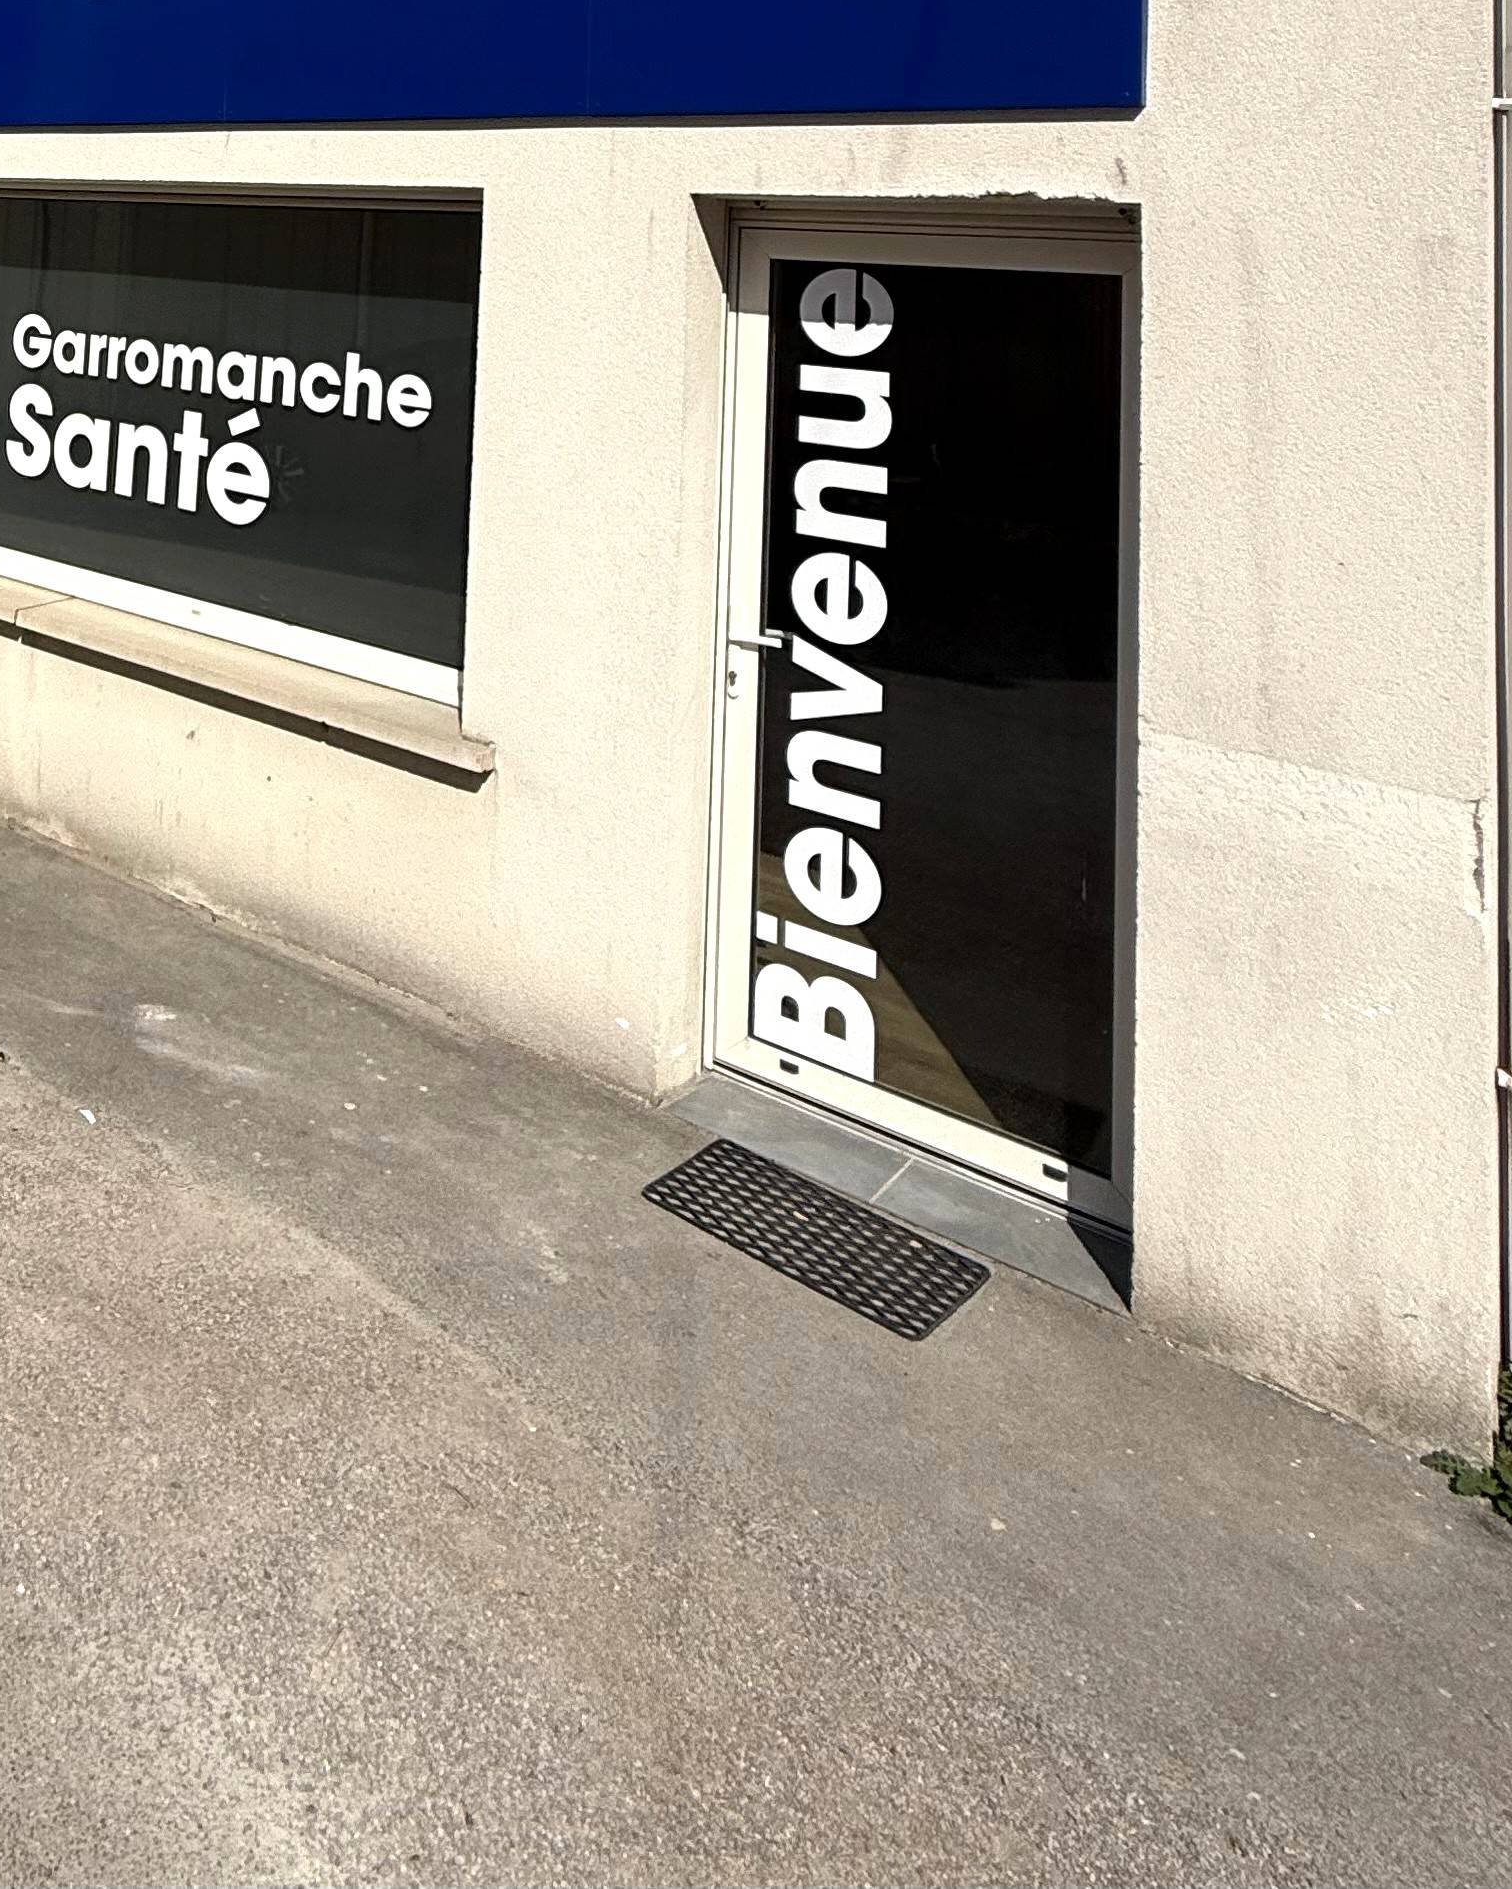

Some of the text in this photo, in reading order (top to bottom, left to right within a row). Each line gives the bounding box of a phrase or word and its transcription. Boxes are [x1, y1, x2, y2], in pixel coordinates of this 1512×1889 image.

[12, 313, 432, 428] Garromanche
[5, 383, 271, 526] Santé
[752, 268, 895, 1083] Bienvenue
